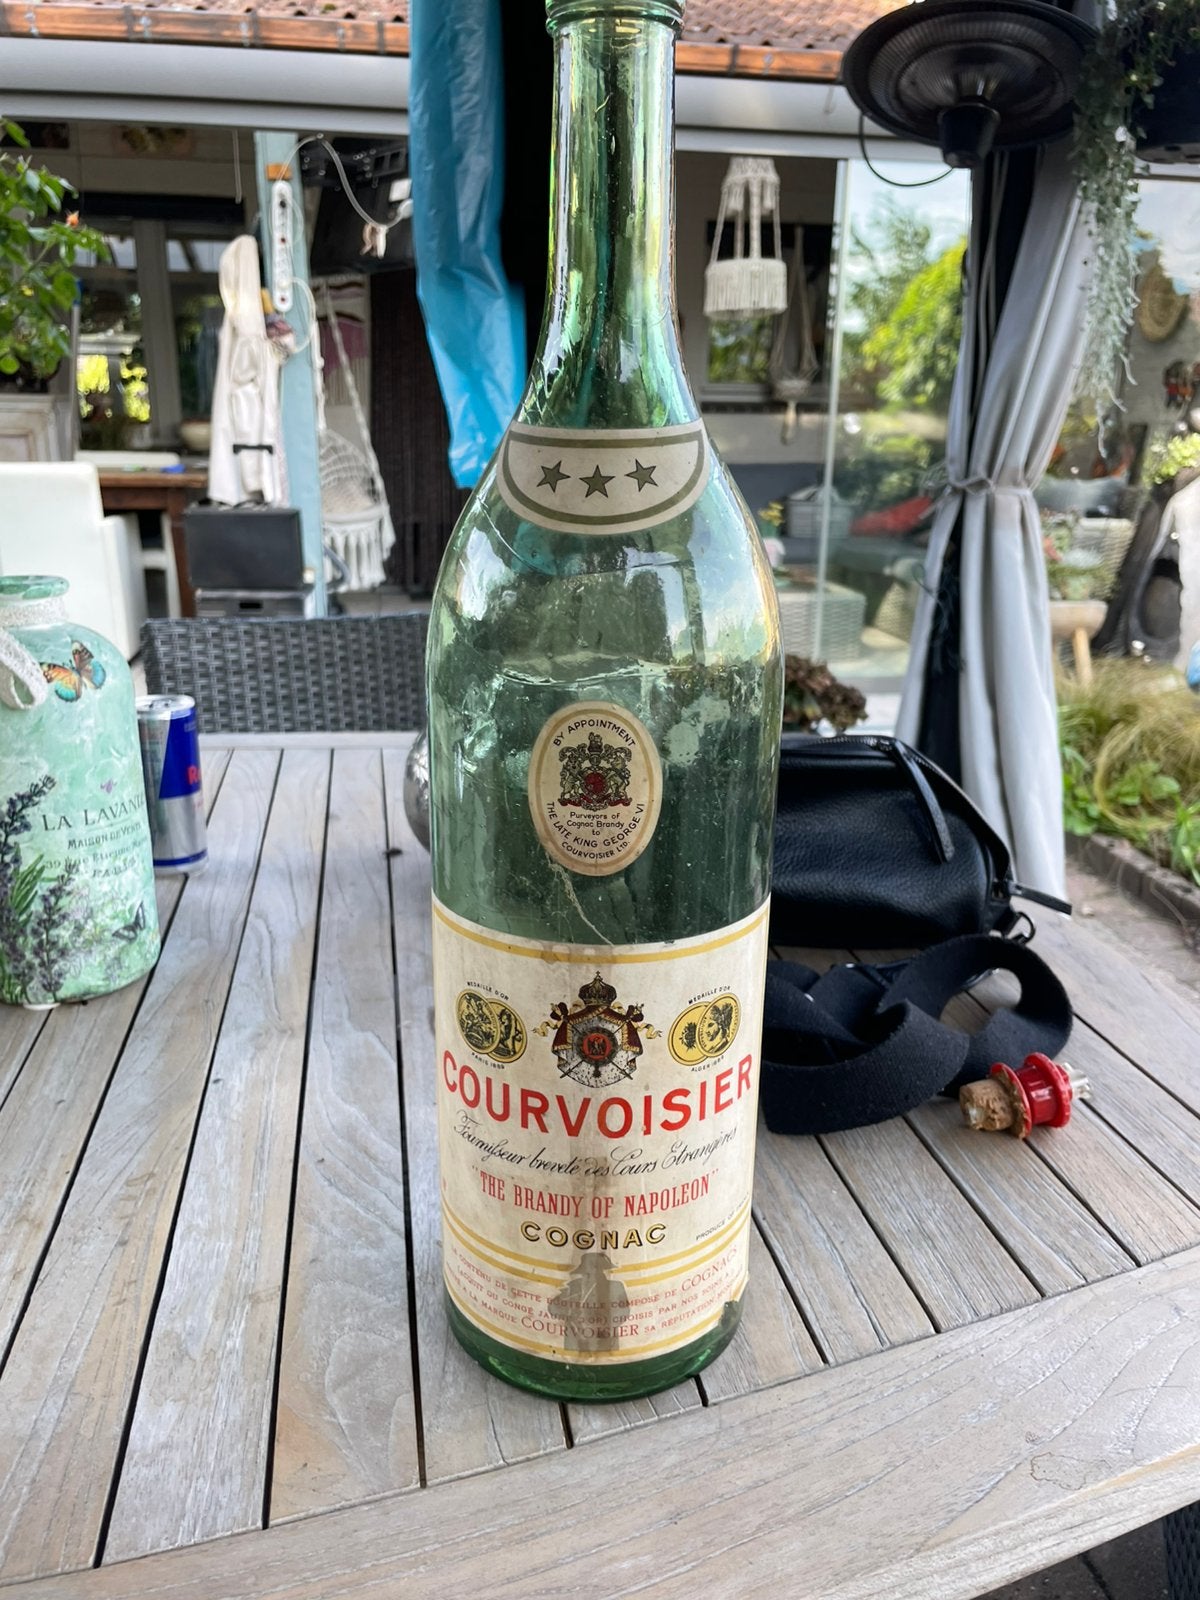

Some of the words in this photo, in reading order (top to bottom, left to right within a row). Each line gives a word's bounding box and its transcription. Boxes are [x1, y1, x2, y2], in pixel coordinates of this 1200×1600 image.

[553, 731, 565, 747] BY
[567, 719, 636, 747] APPOINTMENT
[42, 814, 72, 831] LA
[546, 802, 558, 819] THE
[553, 820, 572, 839] LATE
[573, 836, 598, 848] KING
[603, 816, 641, 847] GEORGE
[637, 803, 645, 813] VI
[566, 820, 594, 829] Cognac
[596, 820, 625, 829] Brandy
[570, 811, 608, 820] Purveyors
[611, 812, 621, 820] of
[67, 834, 108, 850] MAISON
[561, 841, 615, 859] COURVOISIER
[443, 1050, 753, 1139] COURVOISIER
[610, 1145, 658, 1177] Cours
[513, 1184, 584, 1218] BRANDY
[591, 1196, 614, 1219] OF
[520, 1220, 667, 1250] COGNAC
[495, 1280, 507, 1291] DE
[511, 1287, 542, 1303] CETTE
[664, 1288, 678, 1299] DE
[481, 1300, 518, 1324] MARQUE
[521, 1316, 640, 1339] COURVOISIER
[612, 1310, 654, 1323] CHOISIS
[658, 1303, 678, 1315] PAR
[681, 1294, 699, 1307] NOS
